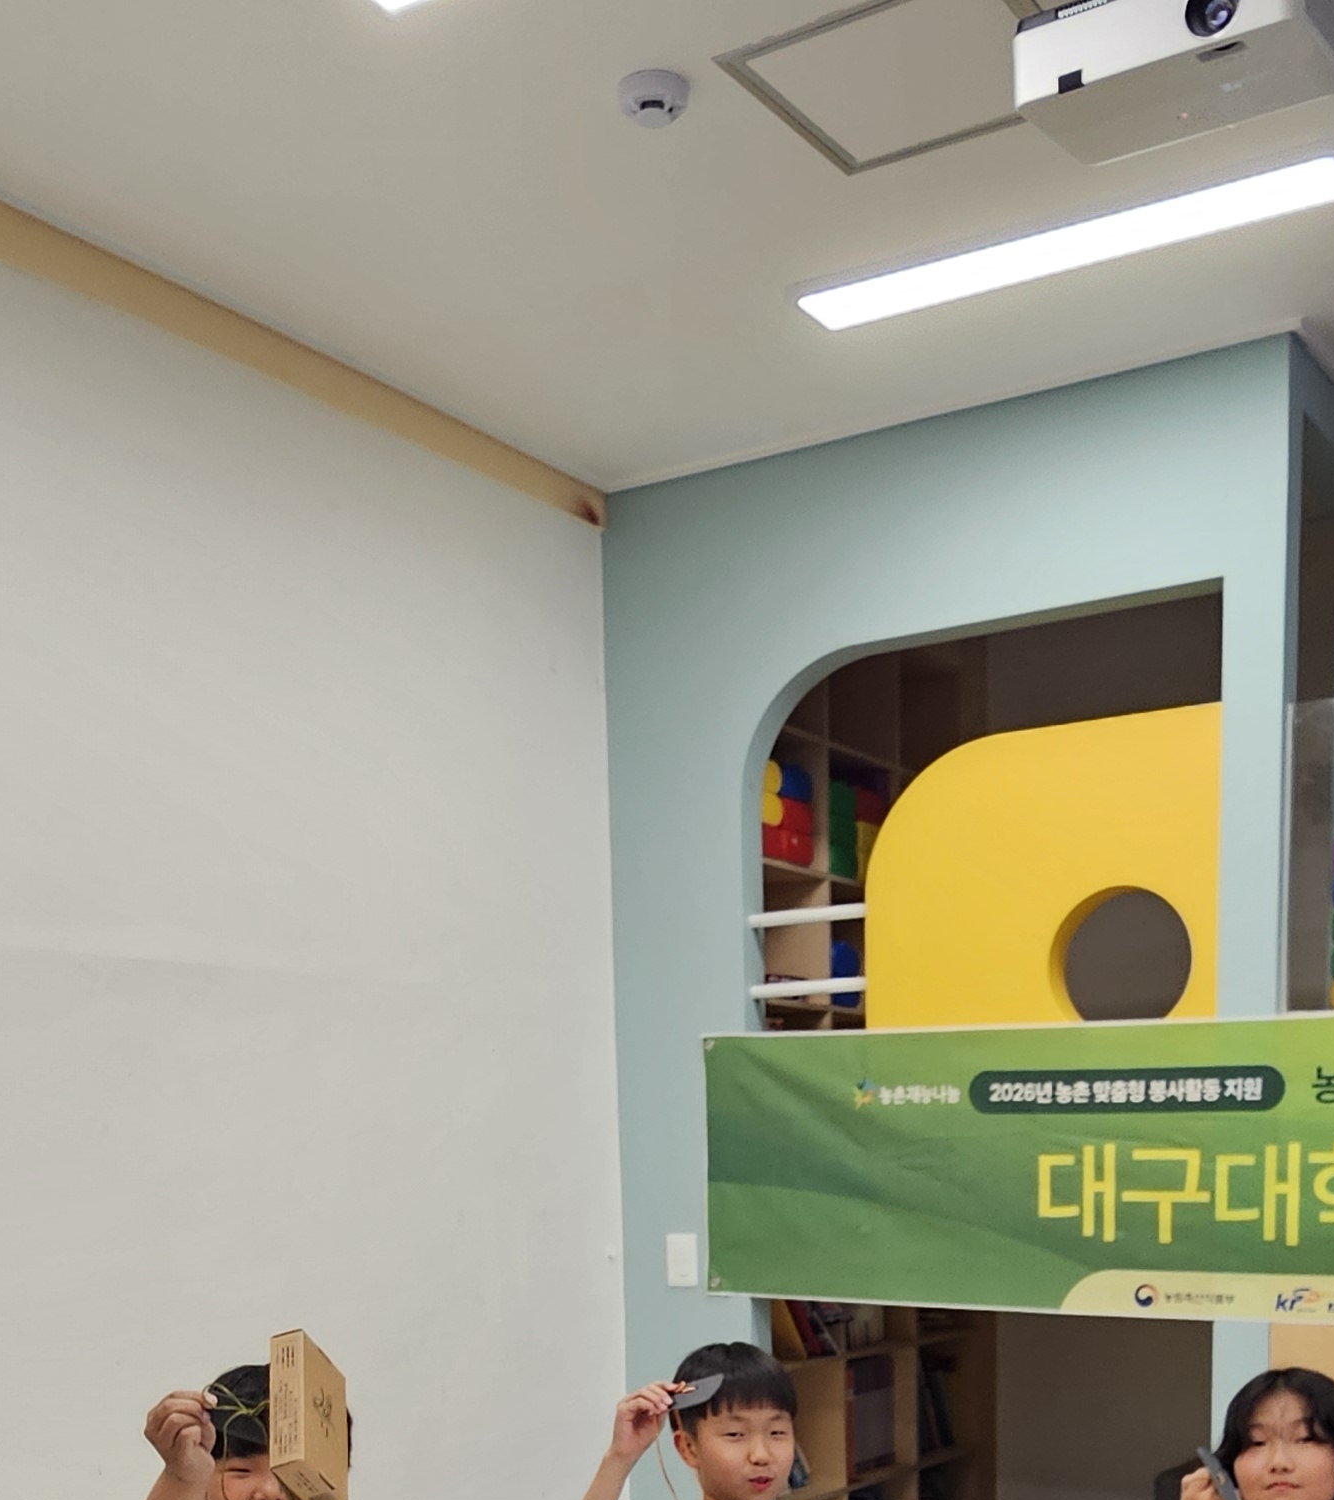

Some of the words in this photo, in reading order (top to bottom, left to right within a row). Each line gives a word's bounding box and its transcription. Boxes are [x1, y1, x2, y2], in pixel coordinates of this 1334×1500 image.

[878, 1084, 961, 1106] 농촌재능나눔
[988, 1080, 1054, 1104] 2026년
[1055, 1080, 1090, 1104] 농촌
[1093, 1079, 1146, 1103] 맞춤형
[1148, 1077, 1221, 1103] 봉사활동
[1223, 1076, 1263, 1101] 지원
